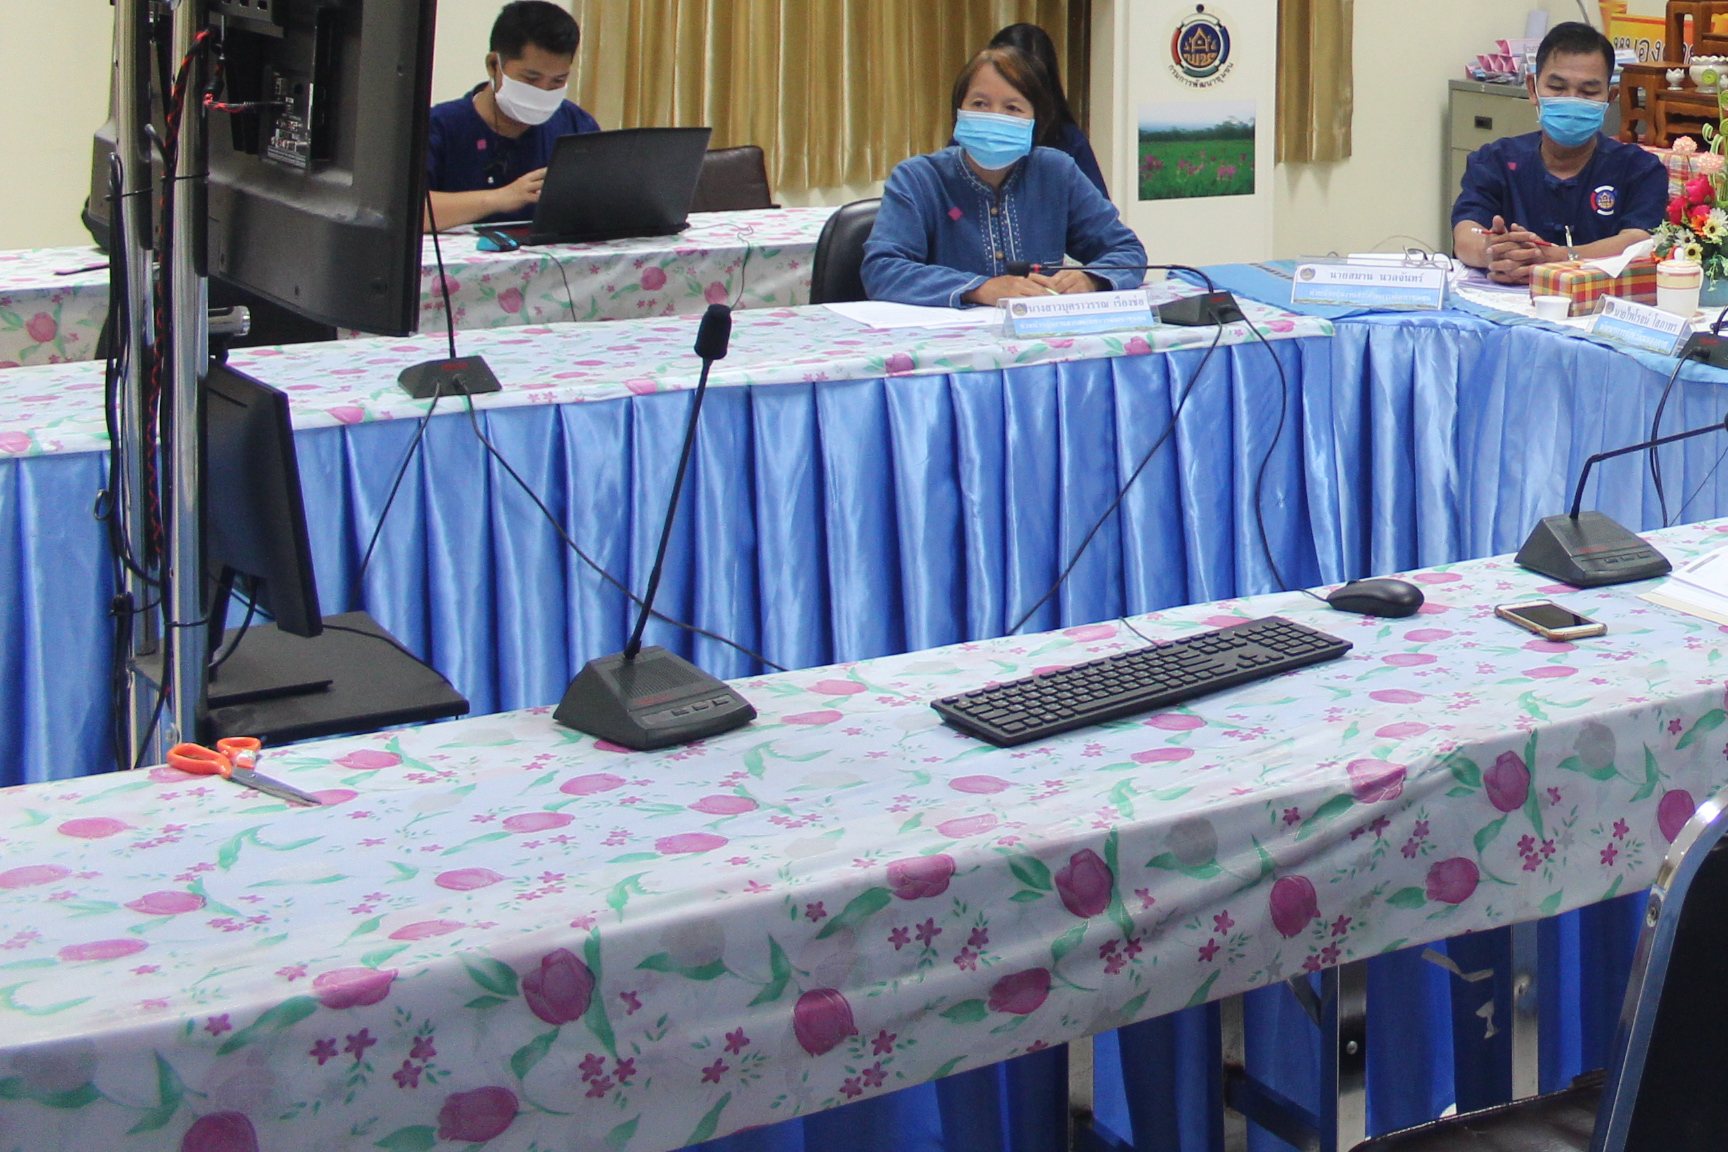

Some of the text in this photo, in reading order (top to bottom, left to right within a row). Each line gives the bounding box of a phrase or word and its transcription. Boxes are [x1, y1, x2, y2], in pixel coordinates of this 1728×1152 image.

[1168, 62, 1234, 88] กรมการพัฒนาชุมชน
